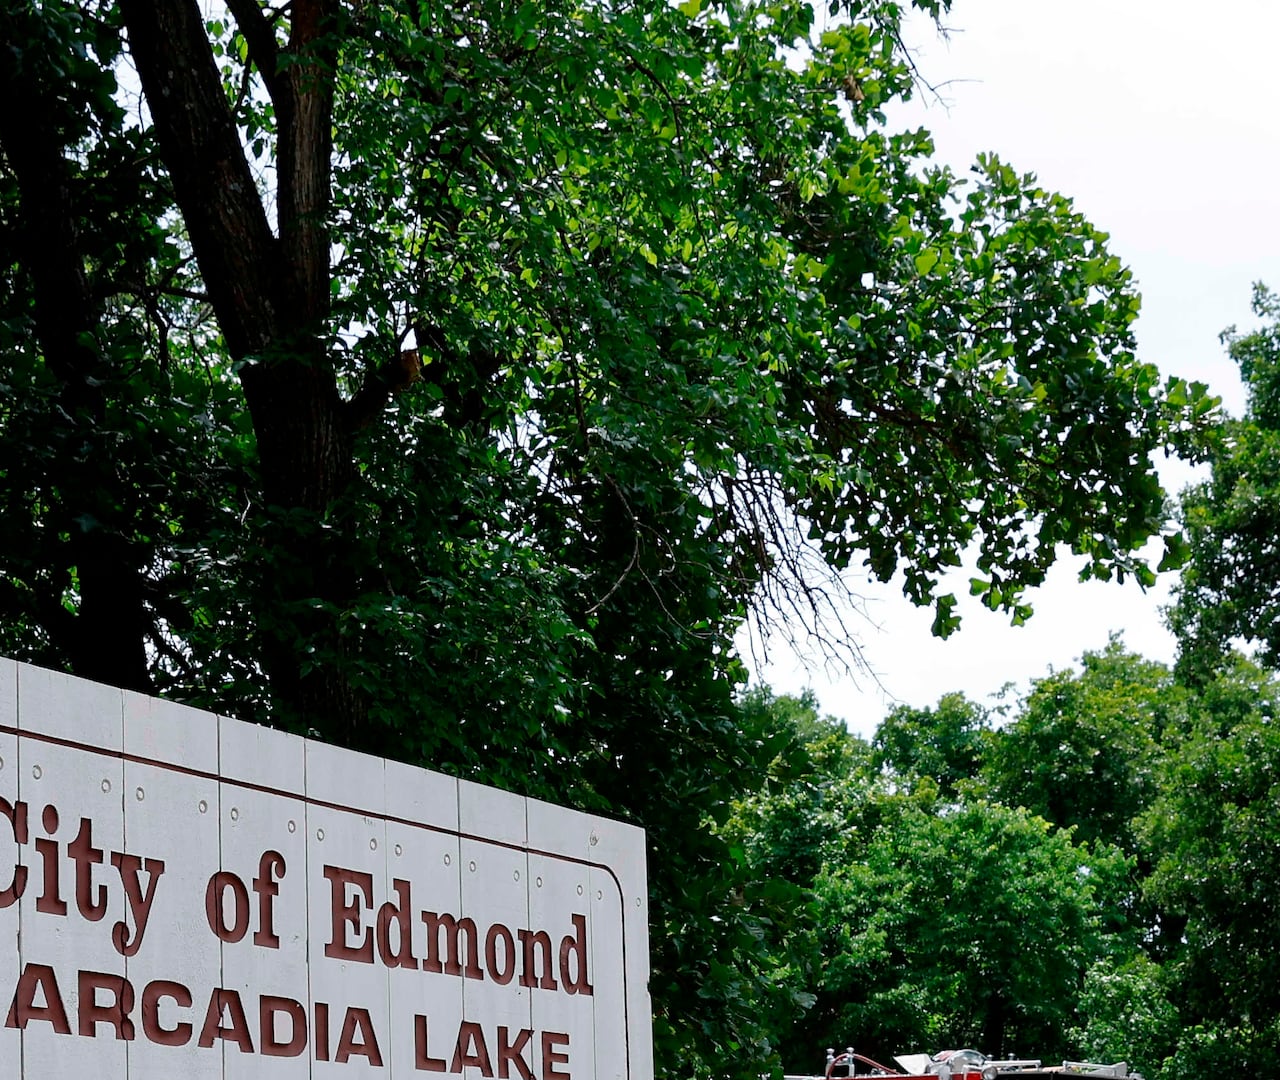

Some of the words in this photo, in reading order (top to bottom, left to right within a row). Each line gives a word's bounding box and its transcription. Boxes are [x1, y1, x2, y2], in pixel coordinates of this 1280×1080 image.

[205, 850, 286, 949] of
[323, 864, 594, 997] Edmond
[4, 962, 384, 1067] ARCADIA
